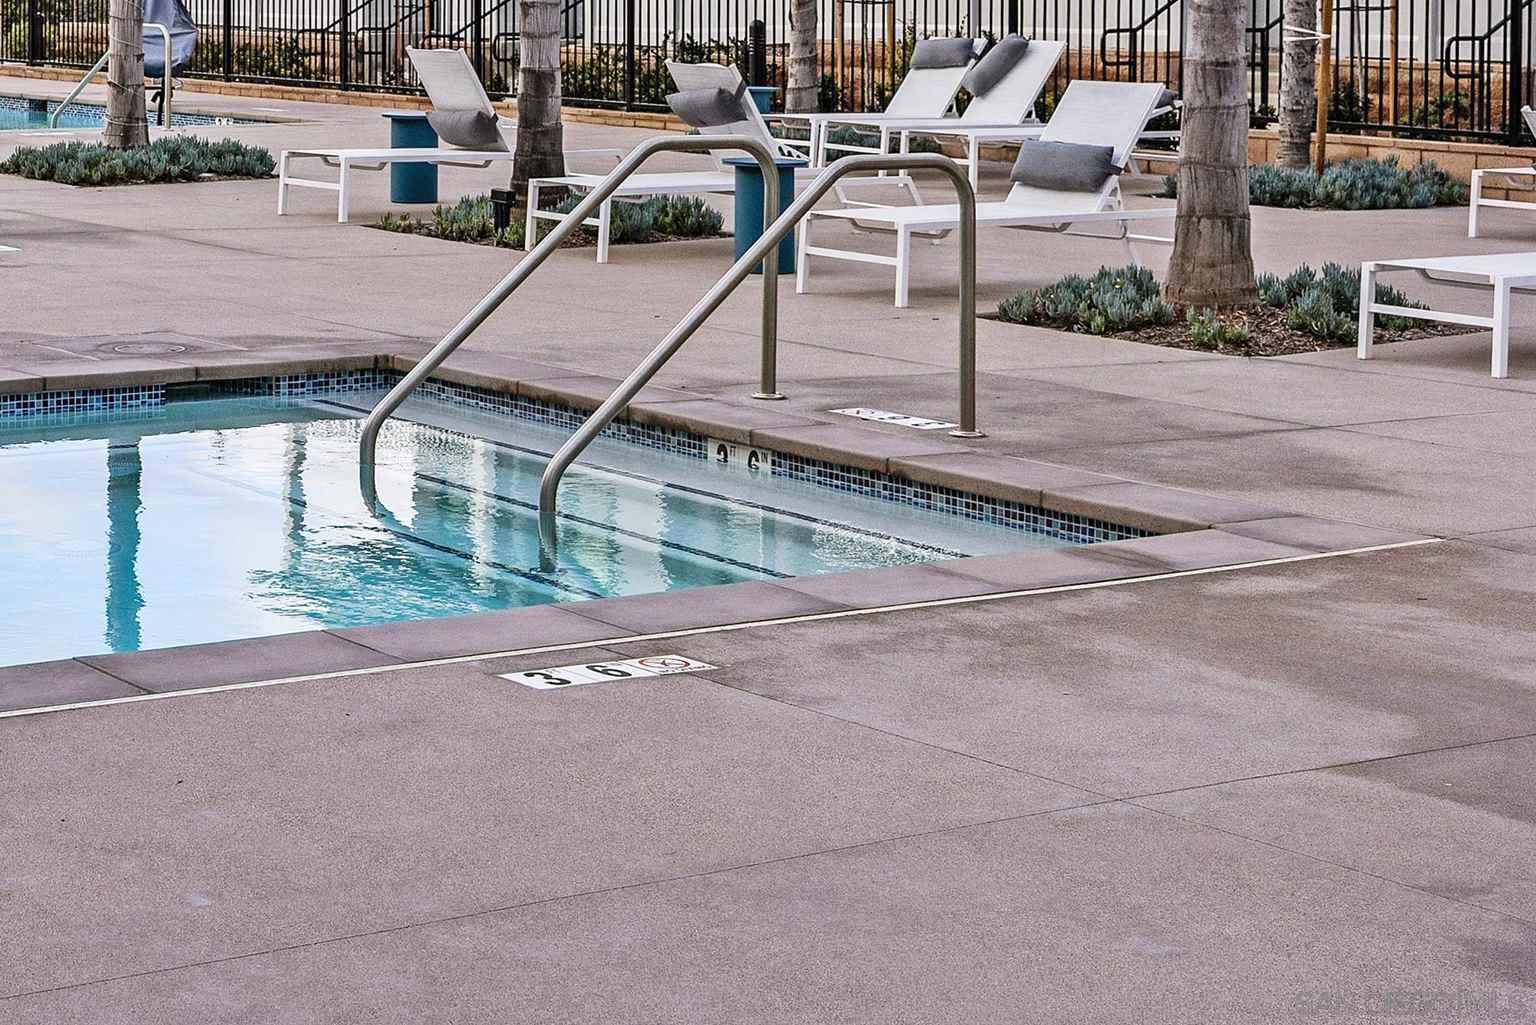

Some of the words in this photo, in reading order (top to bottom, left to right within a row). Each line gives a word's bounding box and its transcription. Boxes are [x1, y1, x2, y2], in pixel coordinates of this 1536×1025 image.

[729, 445, 737, 457] FT
[522, 671, 572, 686] 3
[584, 664, 633, 678] 6
